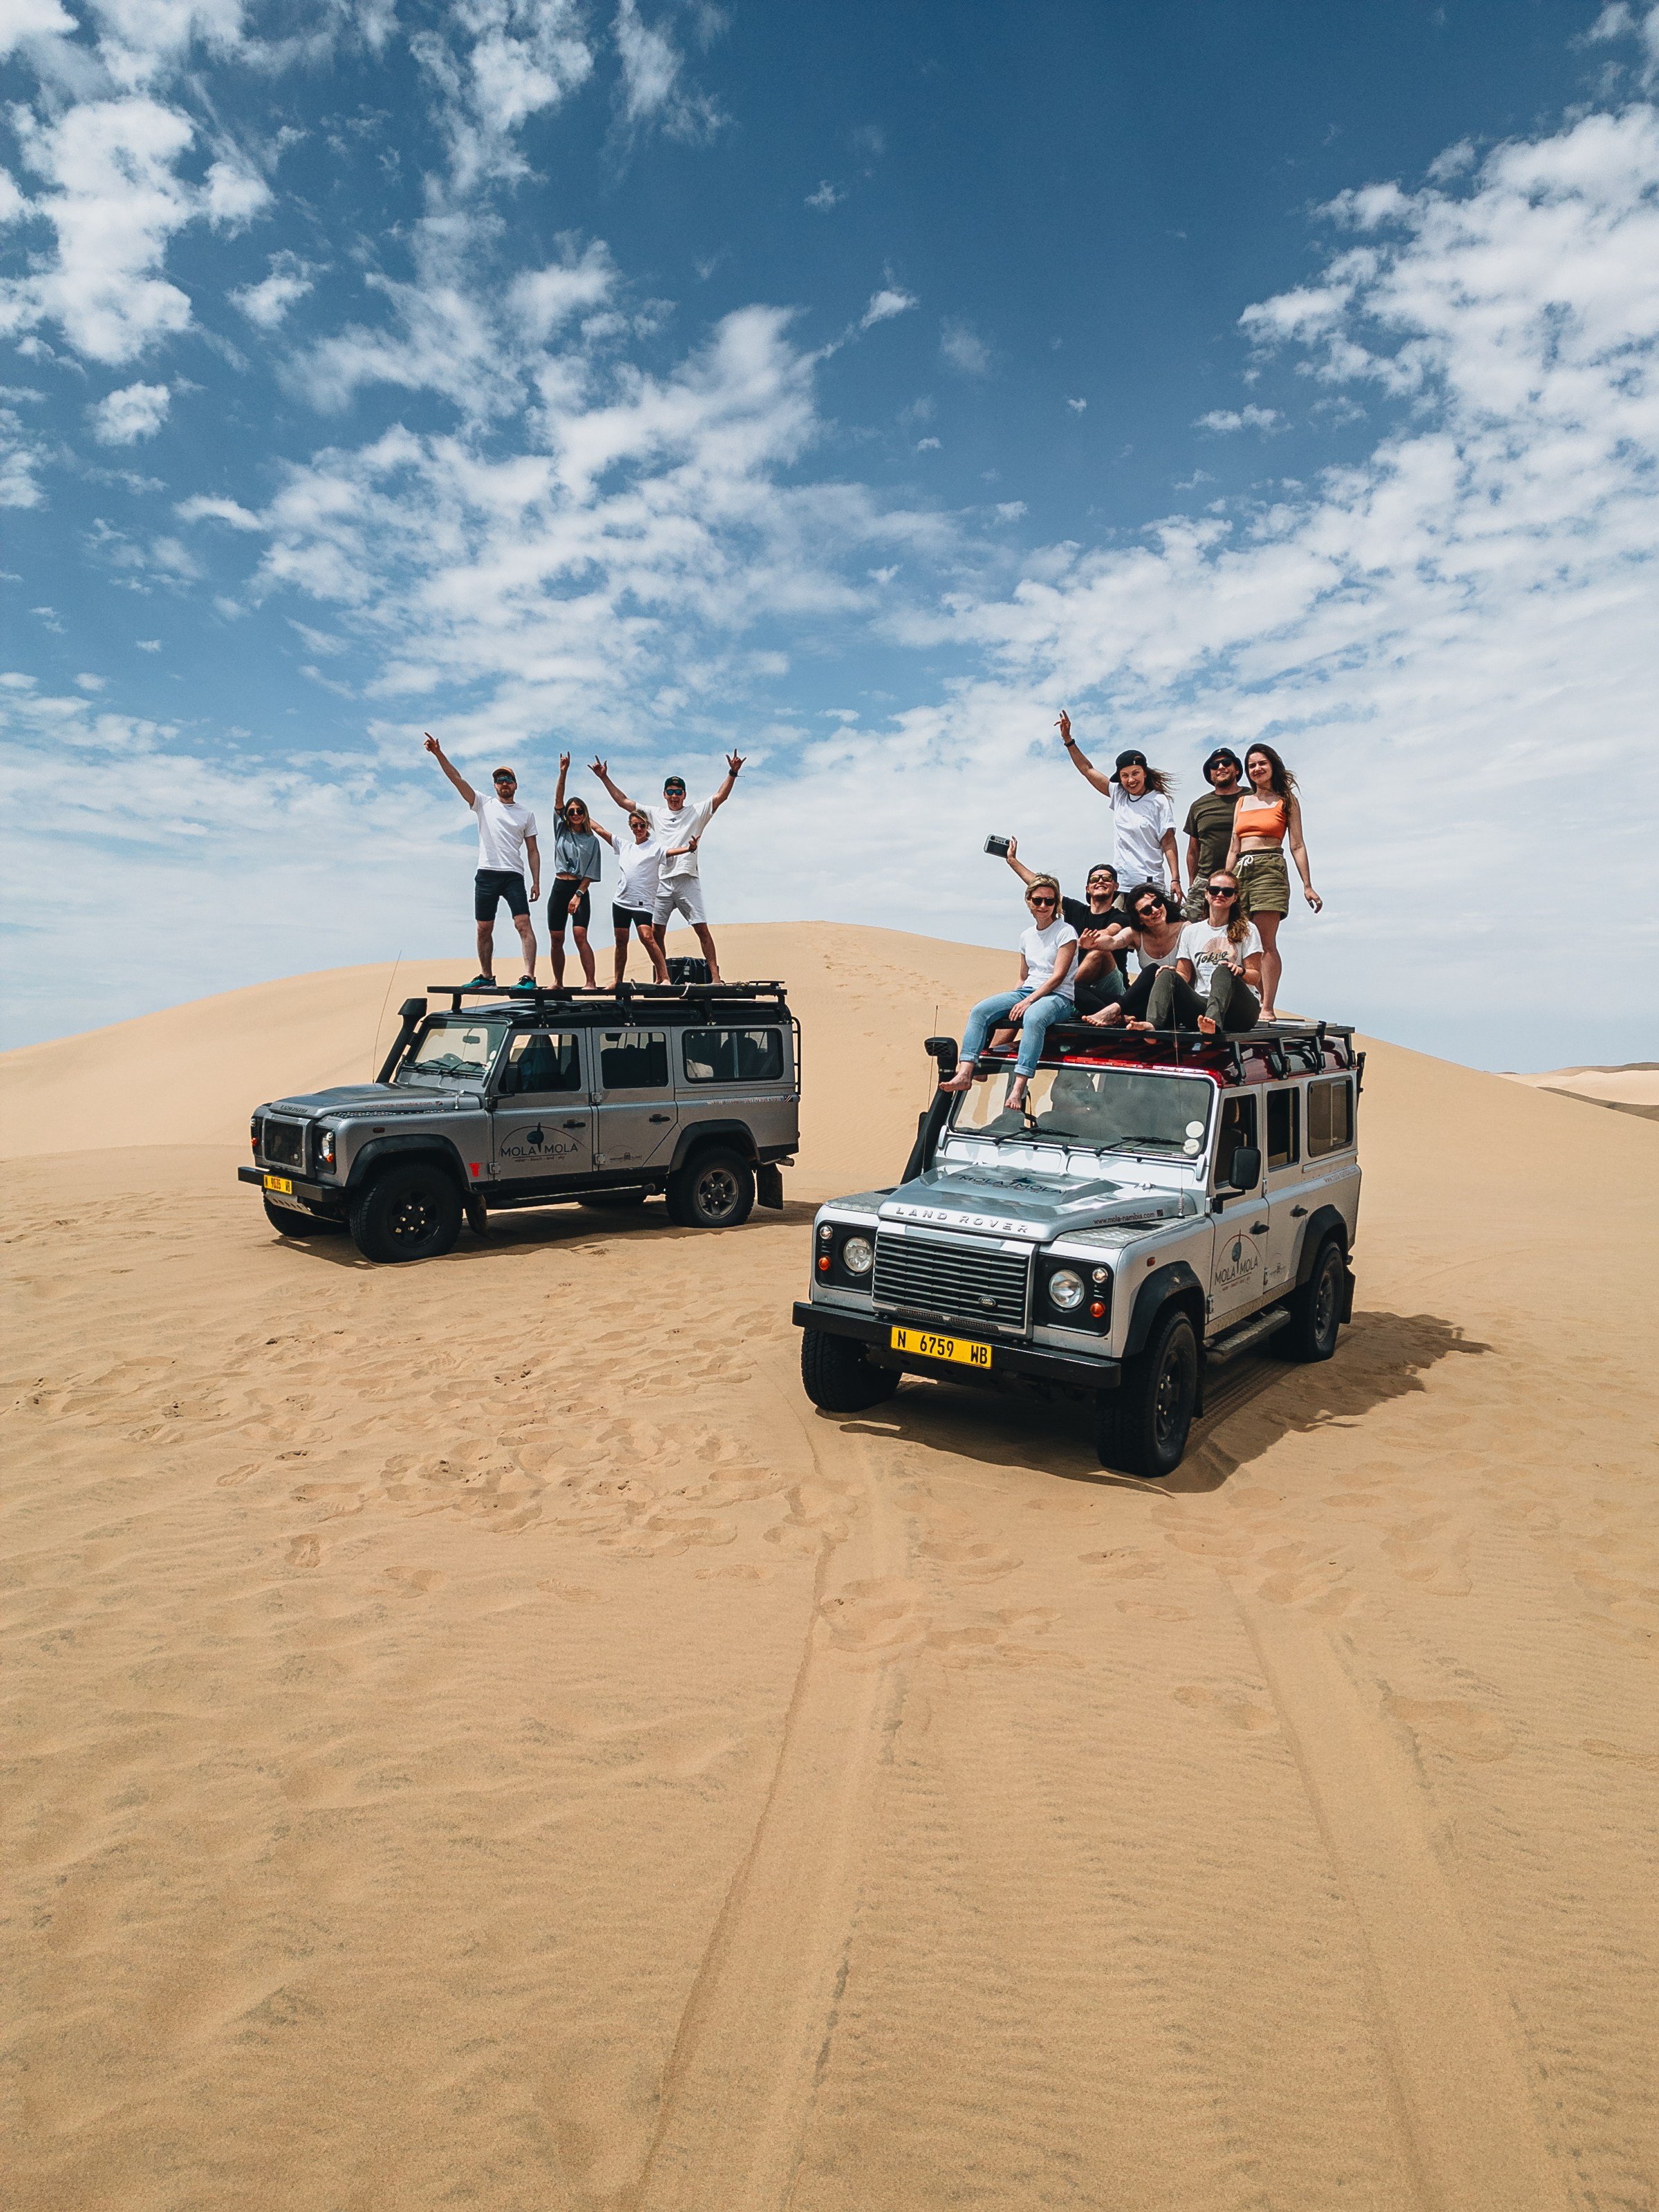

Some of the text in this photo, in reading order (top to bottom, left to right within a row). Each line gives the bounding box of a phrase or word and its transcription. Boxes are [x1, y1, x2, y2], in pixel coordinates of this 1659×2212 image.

[1194, 950, 1228, 968] Tokyo
[500, 1143, 578, 1157] MOLA MOLA
[959, 1175, 1004, 1185] MOLA
[1011, 1183, 1062, 1194] MOLA
[896, 1207, 1029, 1233] LAND ROVER
[1094, 1212, 1155, 1225] www.mola-namibia.com
[1215, 1266, 1236, 1286] MOLA
[1240, 1256, 1258, 1275] MOLA
[897, 1330, 987, 1365] N 6759 WB
